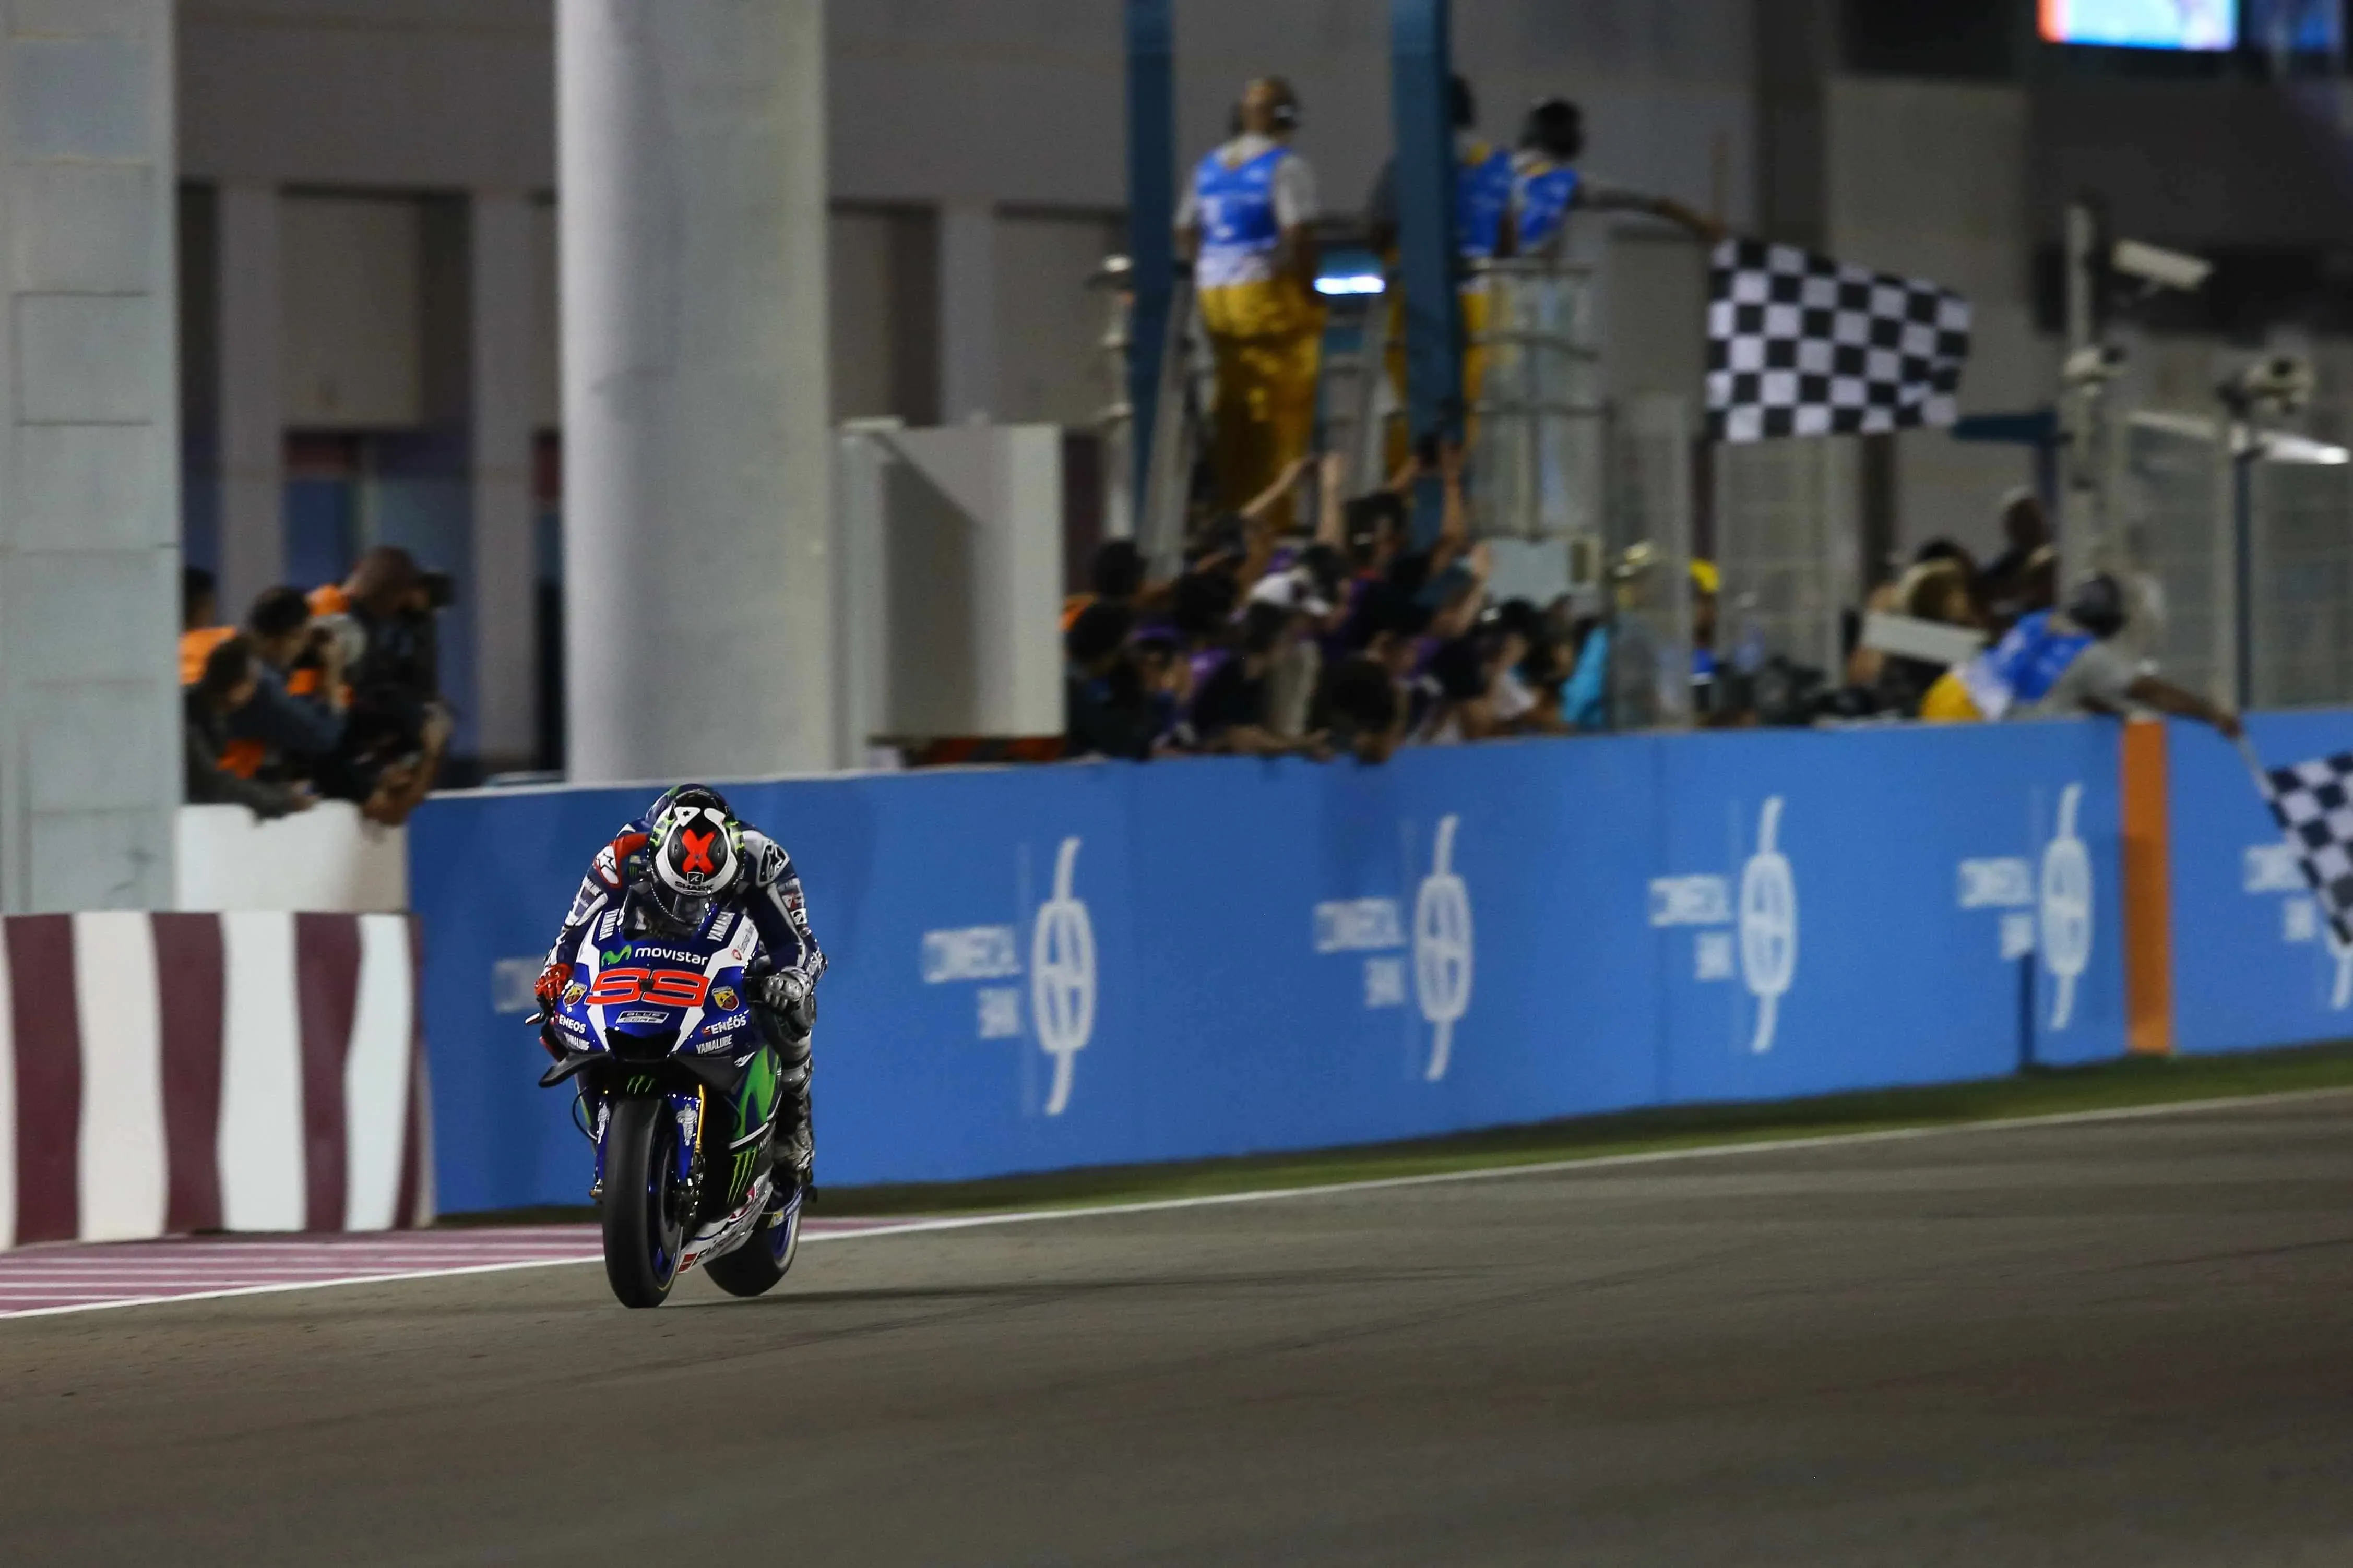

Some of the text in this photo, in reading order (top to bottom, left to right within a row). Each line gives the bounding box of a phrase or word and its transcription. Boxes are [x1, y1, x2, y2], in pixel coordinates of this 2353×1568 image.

[635, 947, 709, 966] movistar
[584, 968, 710, 1008] 99
[558, 1014, 586, 1034] ENEOS
[710, 1015, 747, 1035] ENEOS
[696, 1034, 733, 1055] YAMALUBE
